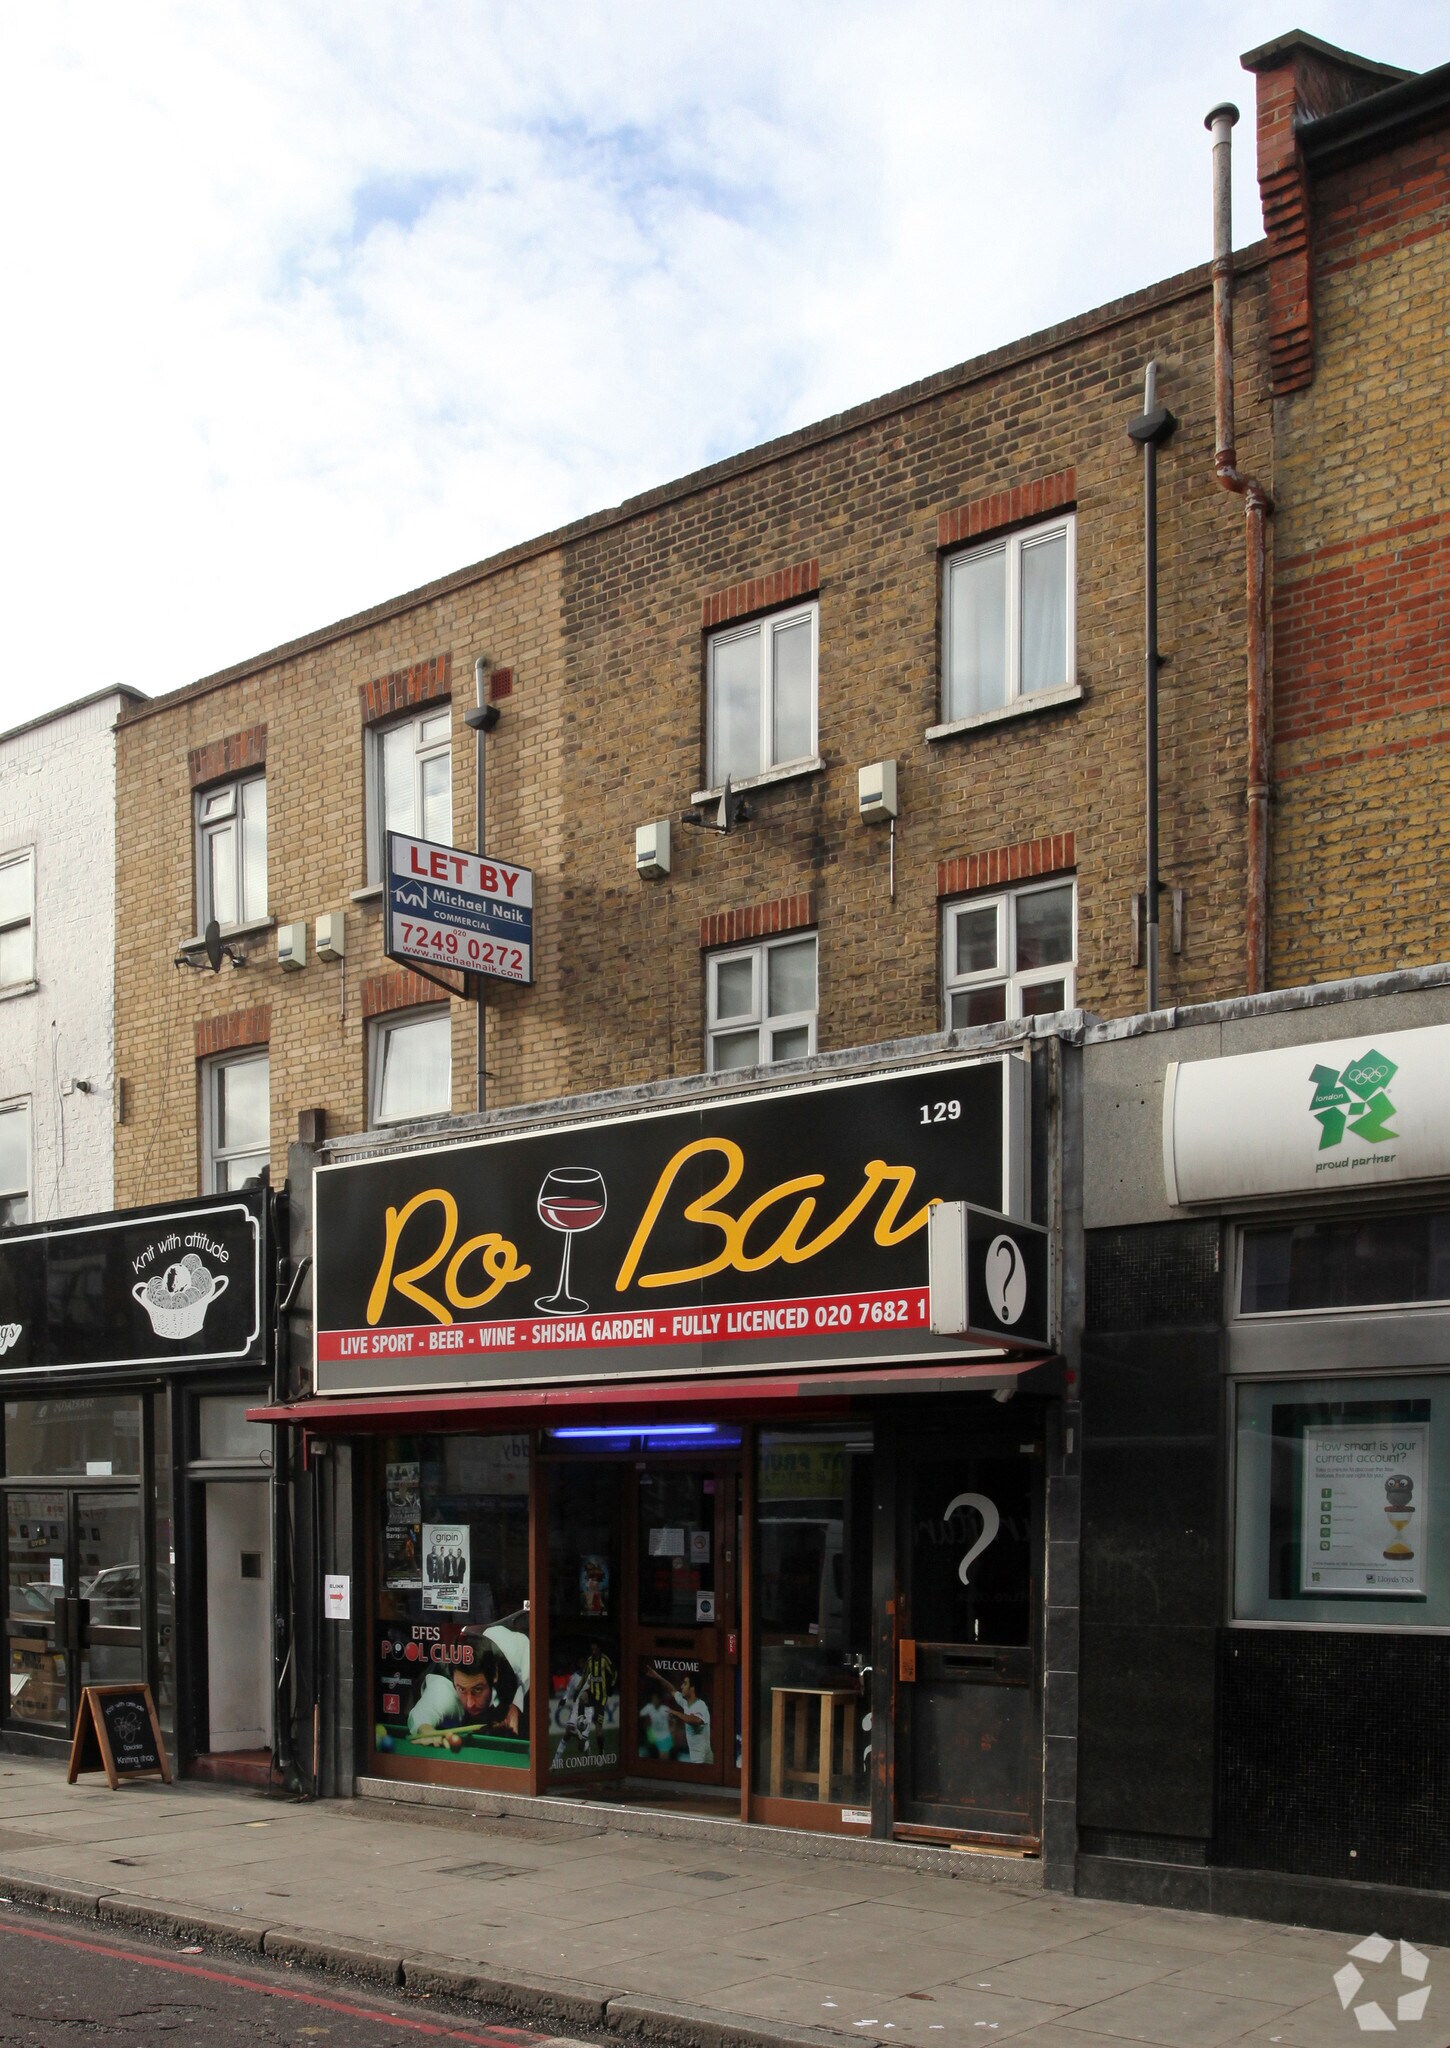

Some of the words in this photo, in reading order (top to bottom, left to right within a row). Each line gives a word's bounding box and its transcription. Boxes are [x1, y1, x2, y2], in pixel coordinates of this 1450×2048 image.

[411, 846, 468, 885] LET
[480, 864, 520, 898] BY
[433, 889, 486, 913] Michael
[492, 904, 524, 923] Naik
[434, 910, 490, 931] COMMERCIAL
[452, 928, 466, 938] 020
[401, 922, 458, 954] 7249
[468, 939, 523, 970] 0272
[402, 946, 524, 980] www.michaelnaik.com
[1316, 1093, 1344, 1102] london
[919, 1099, 962, 1125] 129
[1316, 1157, 1350, 1174] proud
[1352, 1154, 1396, 1169] partner
[366, 1188, 532, 1326] Ro
[615, 1136, 944, 1292] Bar
[132, 1244, 155, 1274] Knit
[158, 1233, 181, 1254] with
[184, 1232, 229, 1262] attitude
[340, 1336, 368, 1355] LIVE
[372, 1333, 414, 1354] SPORT
[429, 1330, 464, 1350] BEER
[480, 1326, 516, 1347] WINE
[532, 1322, 586, 1344] SHISHA
[592, 1318, 654, 1340] GARDEN
[672, 1314, 721, 1336] FULLY
[728, 1308, 808, 1333] LICENCED
[815, 1304, 851, 1328] 020
[858, 1300, 908, 1324] 7682
[1316, 1441, 1342, 1451] How
[1344, 1441, 1376, 1451] smart
[1380, 1440, 1388, 1451] is
[1392, 1442, 1416, 1453] your
[1316, 1453, 1354, 1464] current
[1356, 1452, 1406, 1463] account?
[436, 1532, 458, 1542] gripin
[1377, 1576, 1400, 1584] Lloyds
[412, 1626, 440, 1640] EFES
[382, 1640, 428, 1662] POOL
[430, 1643, 474, 1665] CLUB
[654, 1660, 700, 1672] WELCOME
[552, 1758, 564, 1769] AIR
[566, 1752, 617, 1768] CONDITIONED
